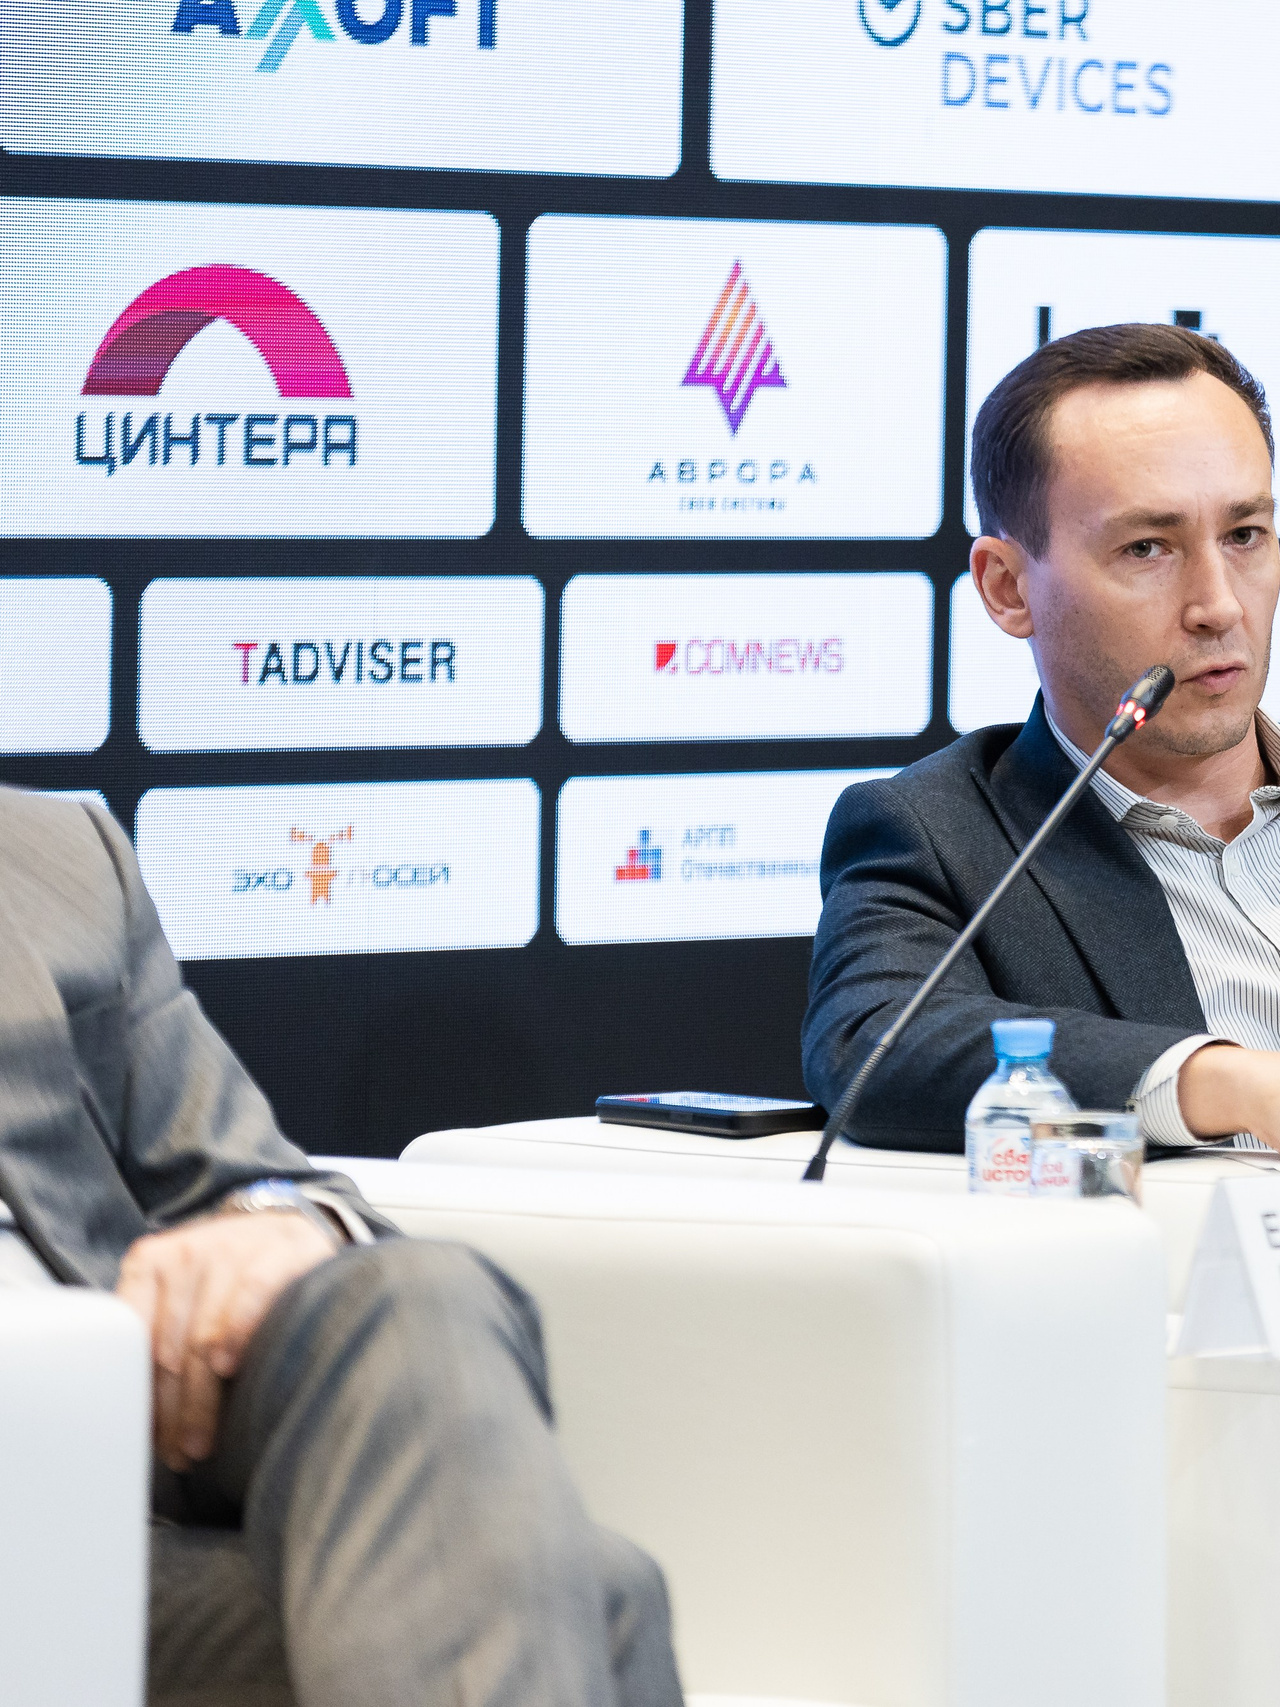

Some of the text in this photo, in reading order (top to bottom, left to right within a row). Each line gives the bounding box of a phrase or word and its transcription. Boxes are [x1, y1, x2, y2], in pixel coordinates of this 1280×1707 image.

[942, 0, 1089, 41] SBER
[942, 51, 1174, 118] DEVICES
[75, 411, 357, 476] ЦИНТЕРА
